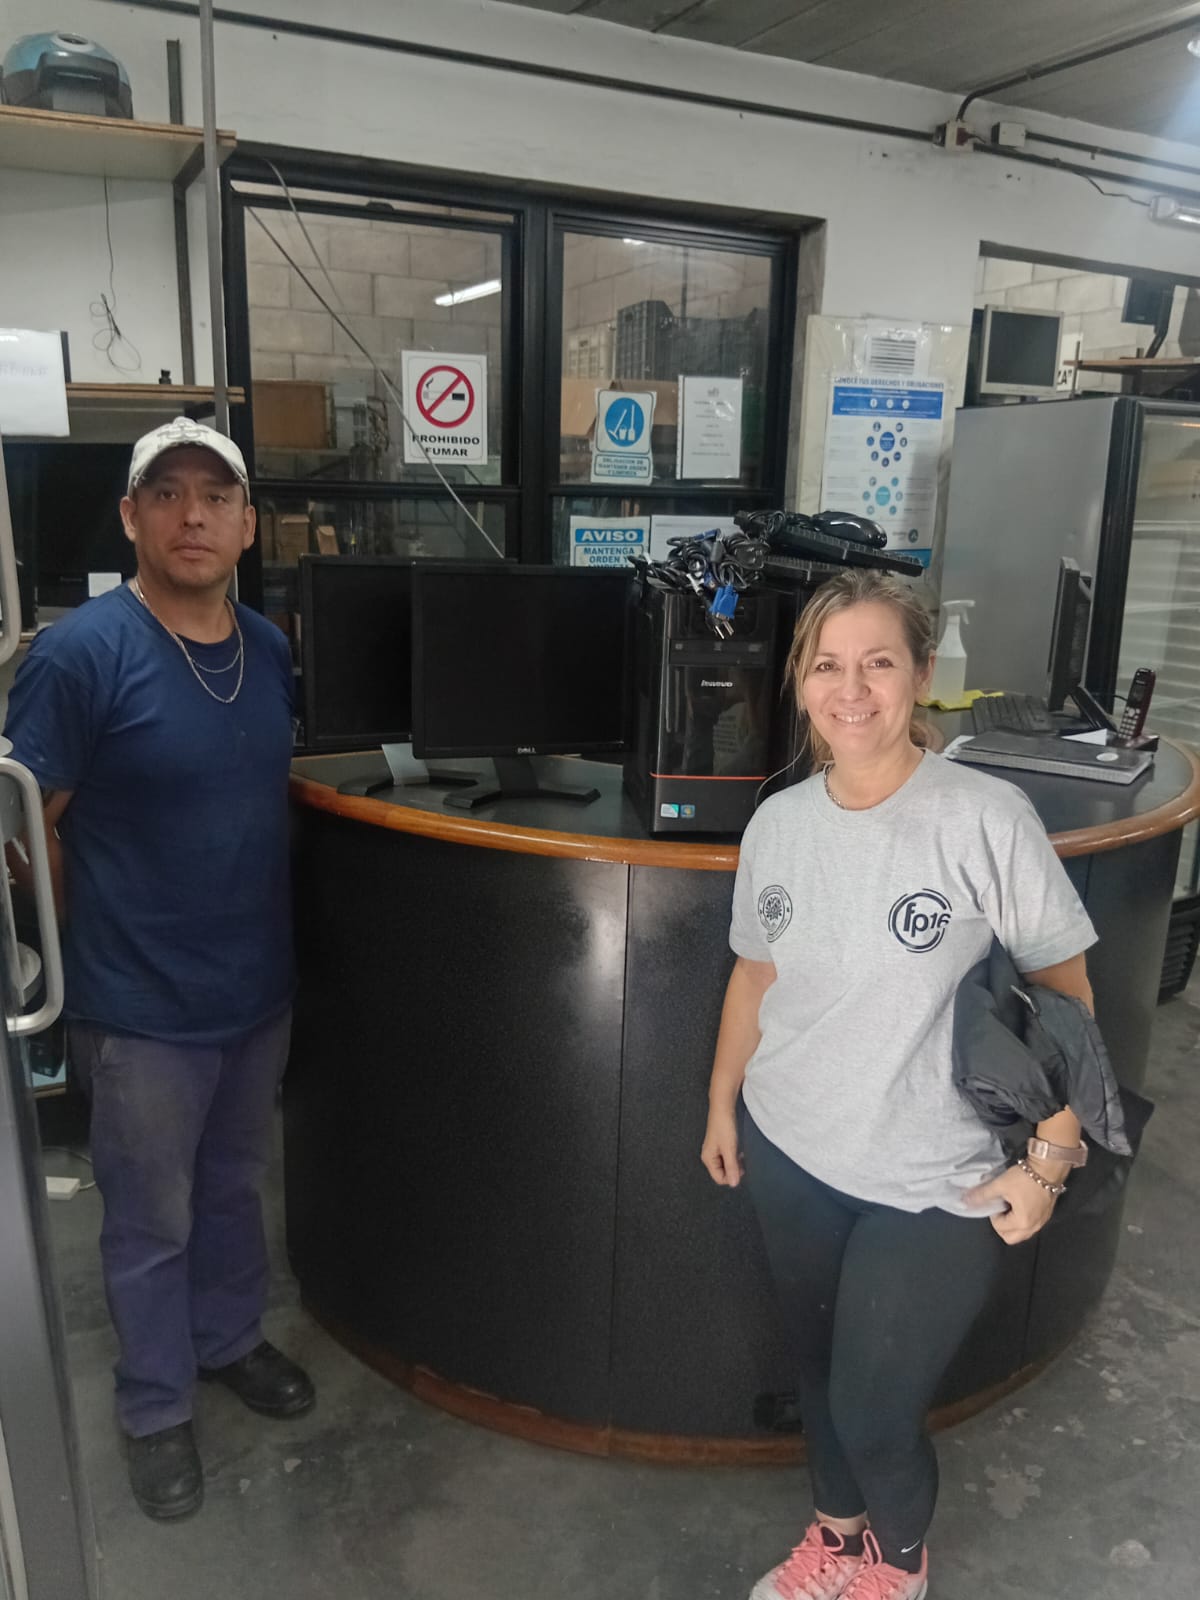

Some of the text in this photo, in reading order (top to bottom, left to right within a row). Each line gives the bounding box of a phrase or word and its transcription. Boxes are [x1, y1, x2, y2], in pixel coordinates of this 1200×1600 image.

[412, 434, 480, 445] PROHIBIDO
[424, 447, 468, 456] FUMAR
[581, 530, 639, 542] AVISO
[583, 547, 635, 555] MANTENGA
[589, 555, 620, 563] ORDEN
[903, 902, 951, 937] fp16
